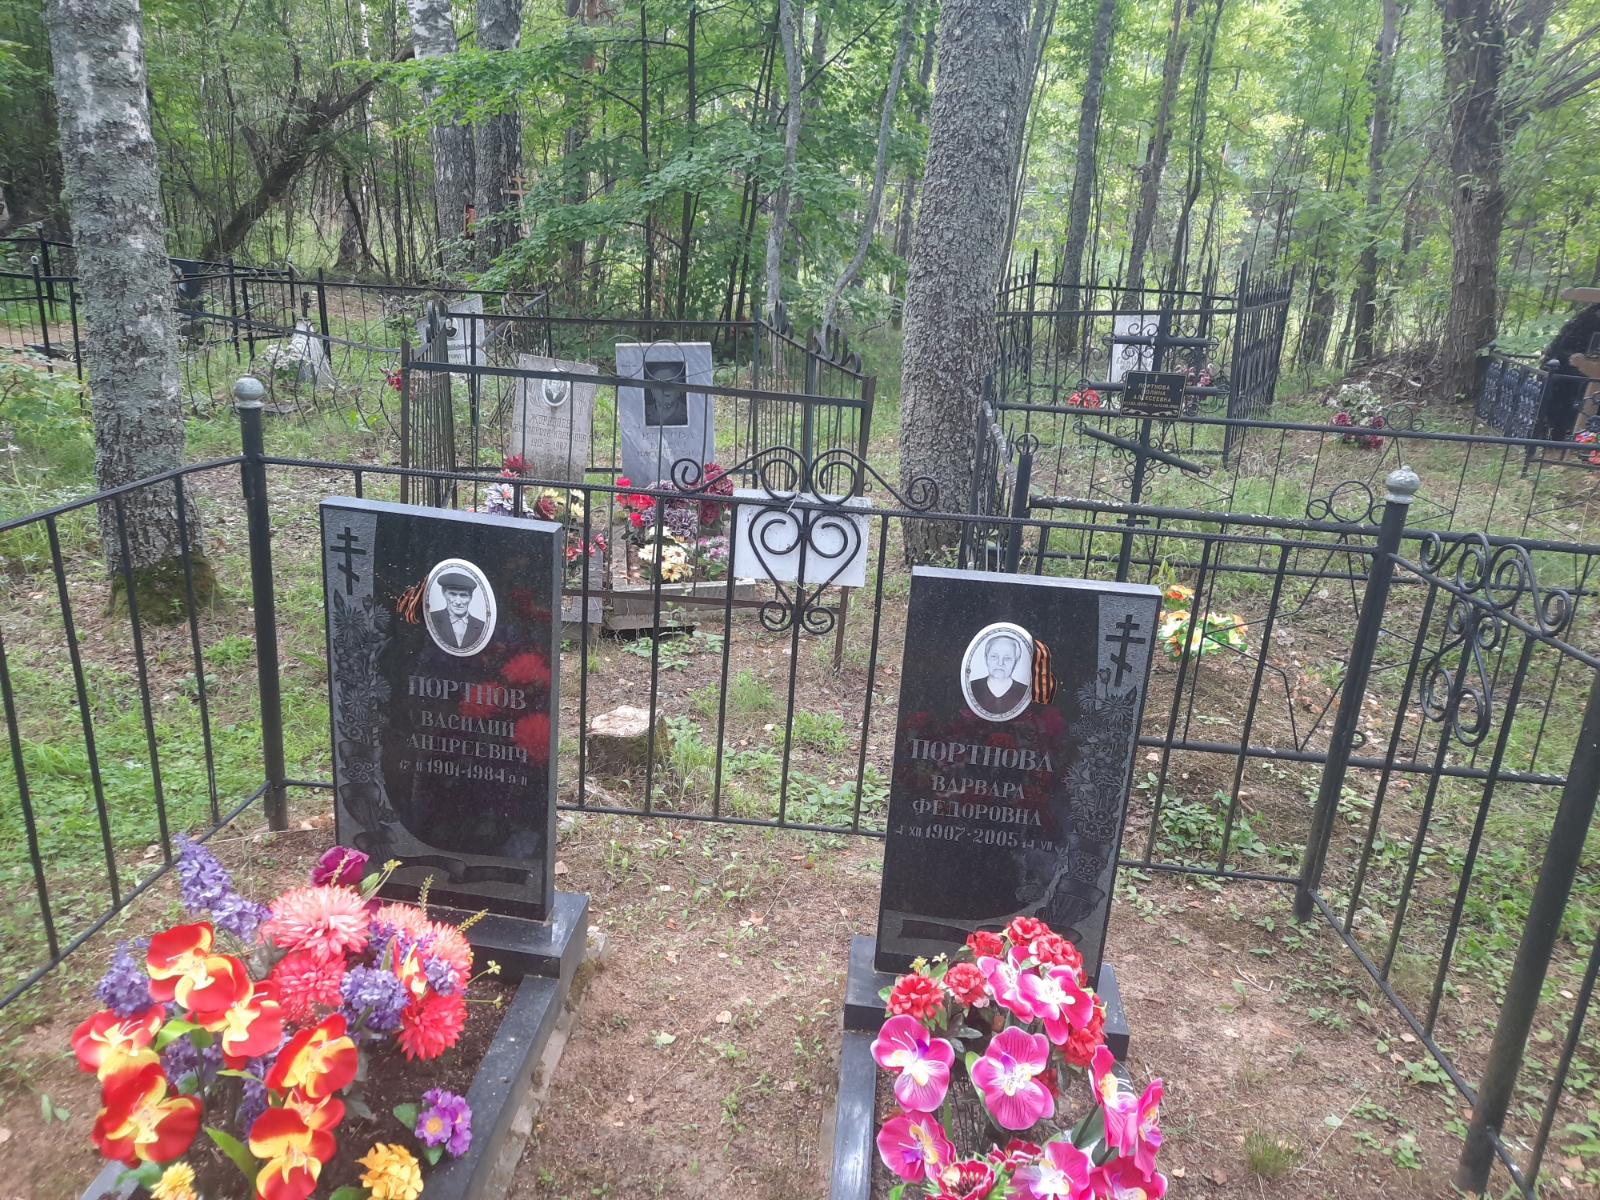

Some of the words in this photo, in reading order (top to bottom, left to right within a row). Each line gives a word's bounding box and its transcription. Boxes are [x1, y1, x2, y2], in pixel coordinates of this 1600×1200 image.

[1133, 394, 1171, 402] АЛКСЕЕВНА
[408, 675, 527, 710] ПОРТНОВ
[421, 710, 516, 738] ВАСИЛИЙ
[407, 733, 528, 764] АНДРЕЕВИЧ
[911, 738, 1054, 773] ПОРТНОВА
[931, 774, 1026, 800] ВАРВАРА
[912, 798, 1043, 827] ФЕДОРОВНА
